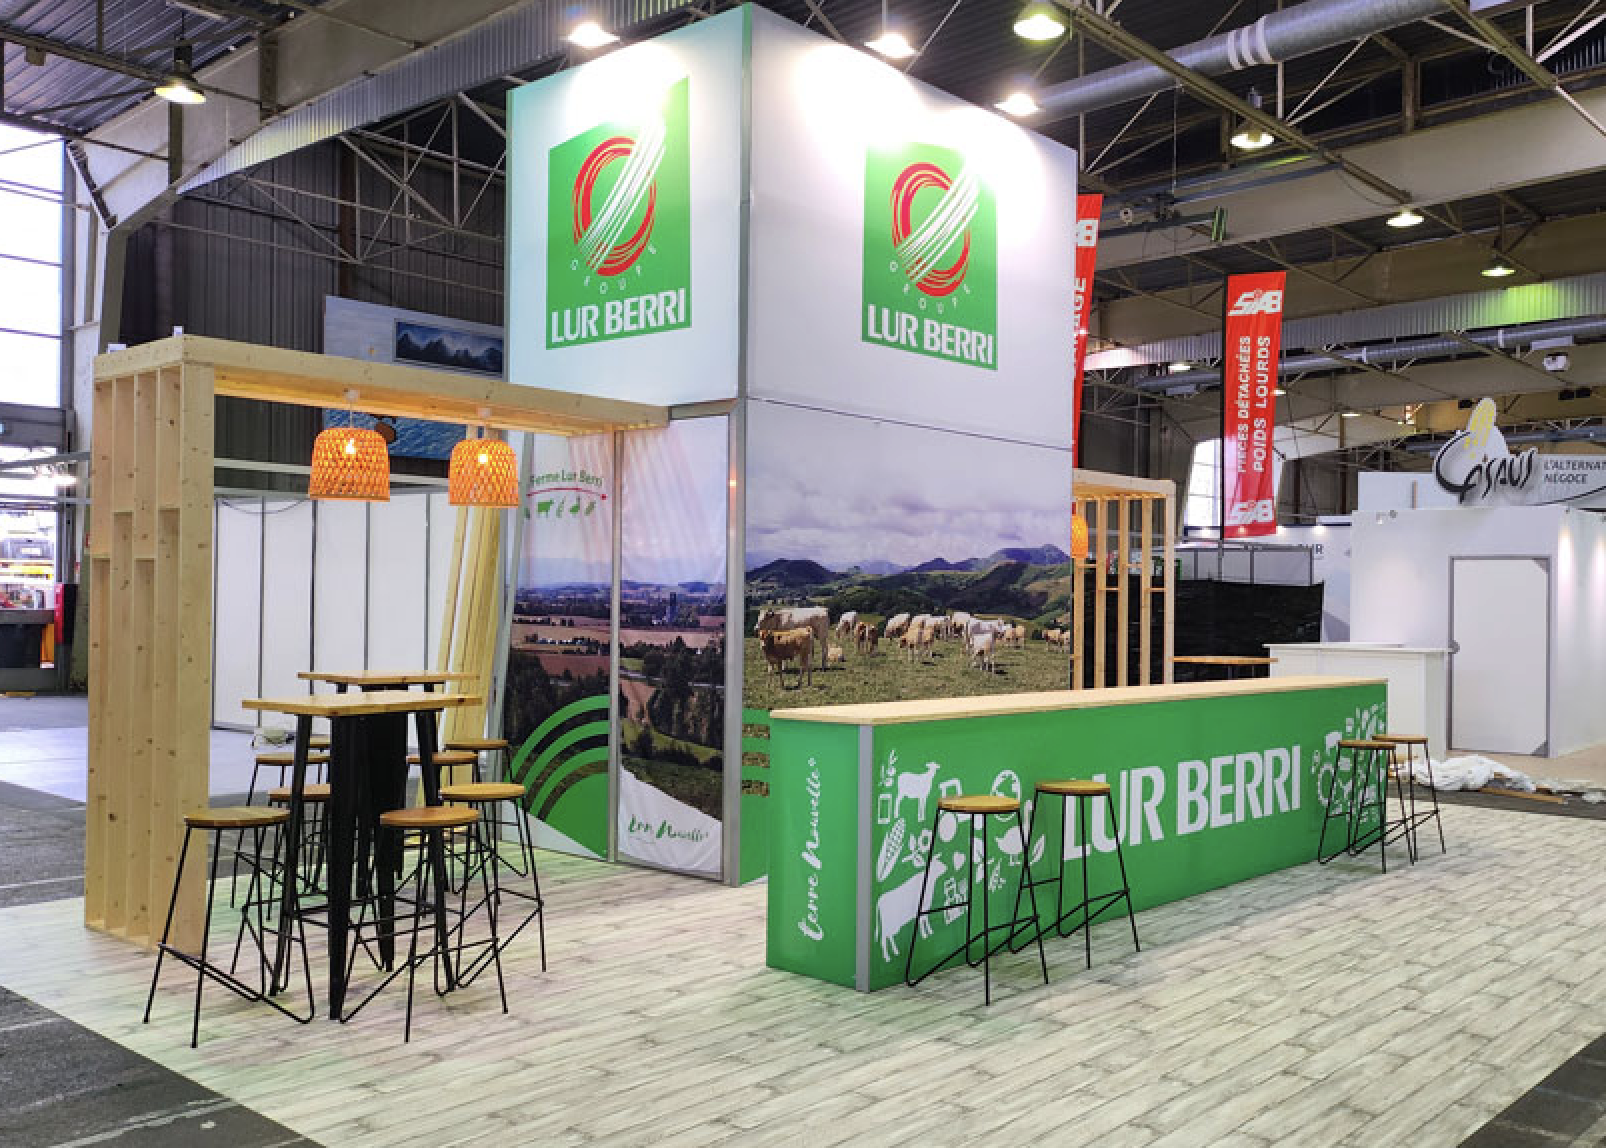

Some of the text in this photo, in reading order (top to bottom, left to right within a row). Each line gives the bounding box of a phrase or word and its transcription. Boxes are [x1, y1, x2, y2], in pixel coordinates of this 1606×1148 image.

[551, 287, 687, 343] LUR BERRI
[868, 303, 994, 365] LUR BERRI
[1253, 335, 1271, 473] POIDS LOURDS
[1063, 744, 1301, 862] LUR BERRI
